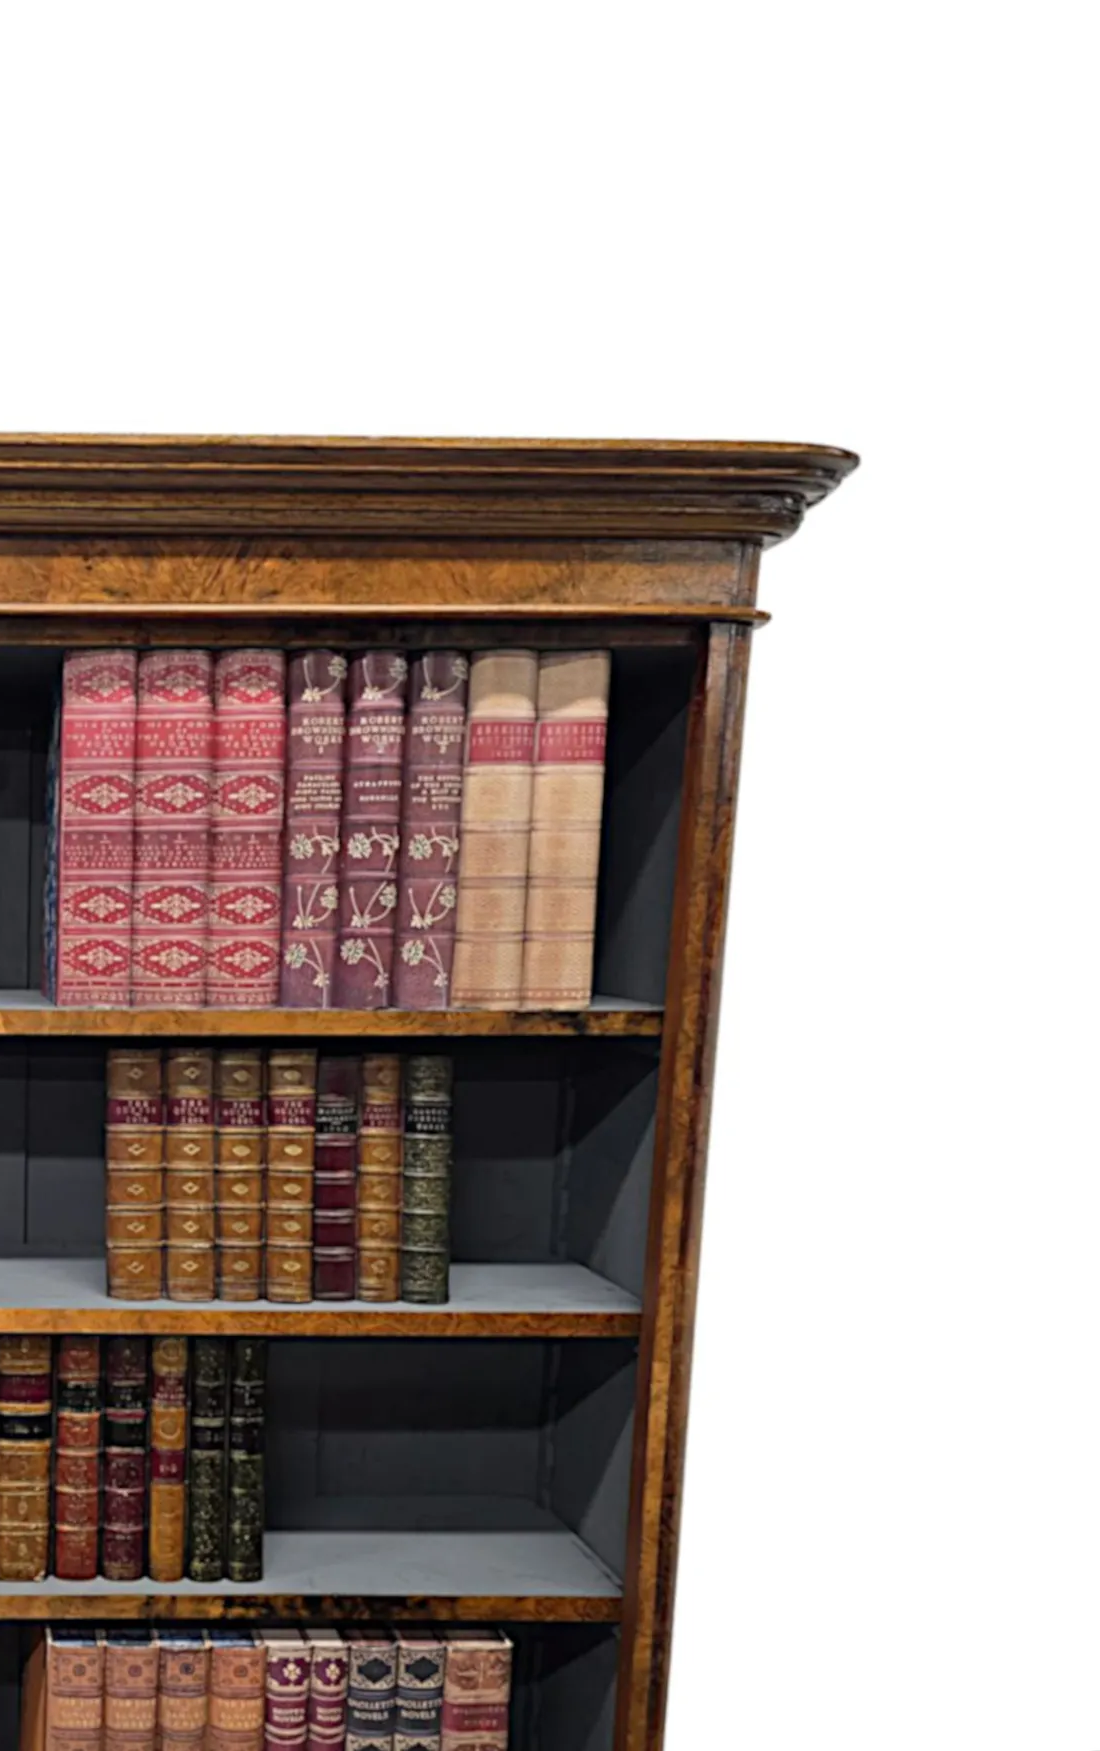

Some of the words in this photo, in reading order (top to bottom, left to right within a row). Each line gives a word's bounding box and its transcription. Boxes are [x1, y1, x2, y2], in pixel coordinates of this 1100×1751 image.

[302, 715, 344, 726] ROBERT
[359, 715, 404, 725] ROBERT
[420, 715, 464, 725] ROBERT
[353, 1710, 390, 1721] NOVELS
[400, 1709, 437, 1720] NOVELS
